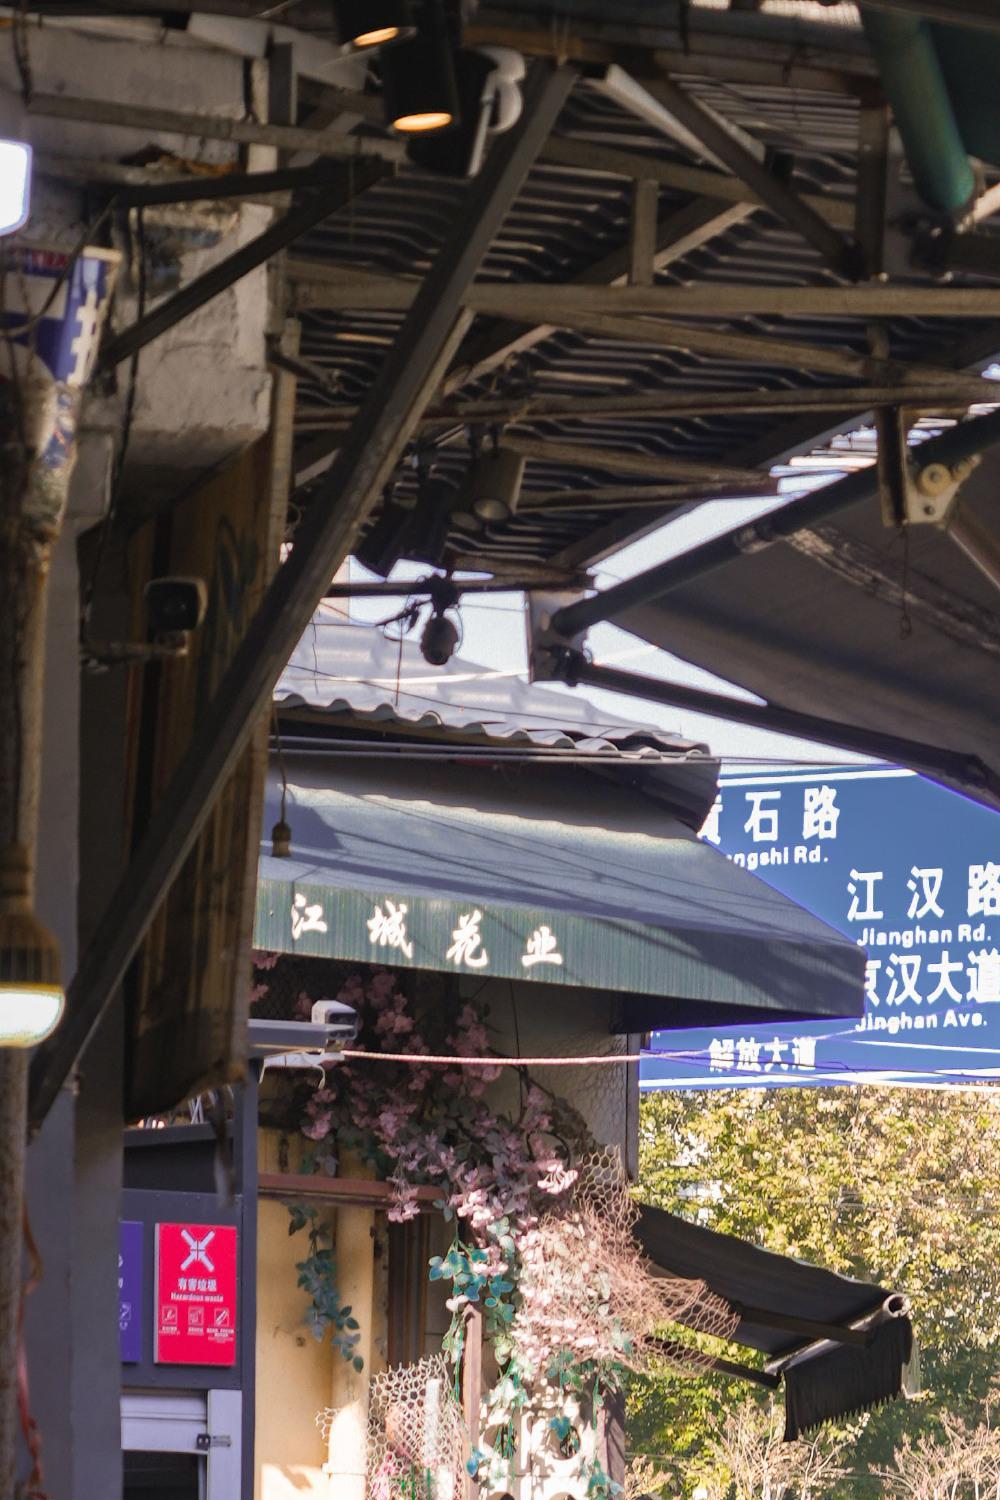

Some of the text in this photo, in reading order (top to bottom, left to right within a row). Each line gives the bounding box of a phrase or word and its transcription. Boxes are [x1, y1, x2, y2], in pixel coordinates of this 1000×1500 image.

[727, 845, 829, 870] ngshi Rd.
[291, 892, 564, 968] 江城花业
[857, 923, 992, 948] Jianghan Rd.
[855, 1009, 988, 1034] Jinghan Ave.
